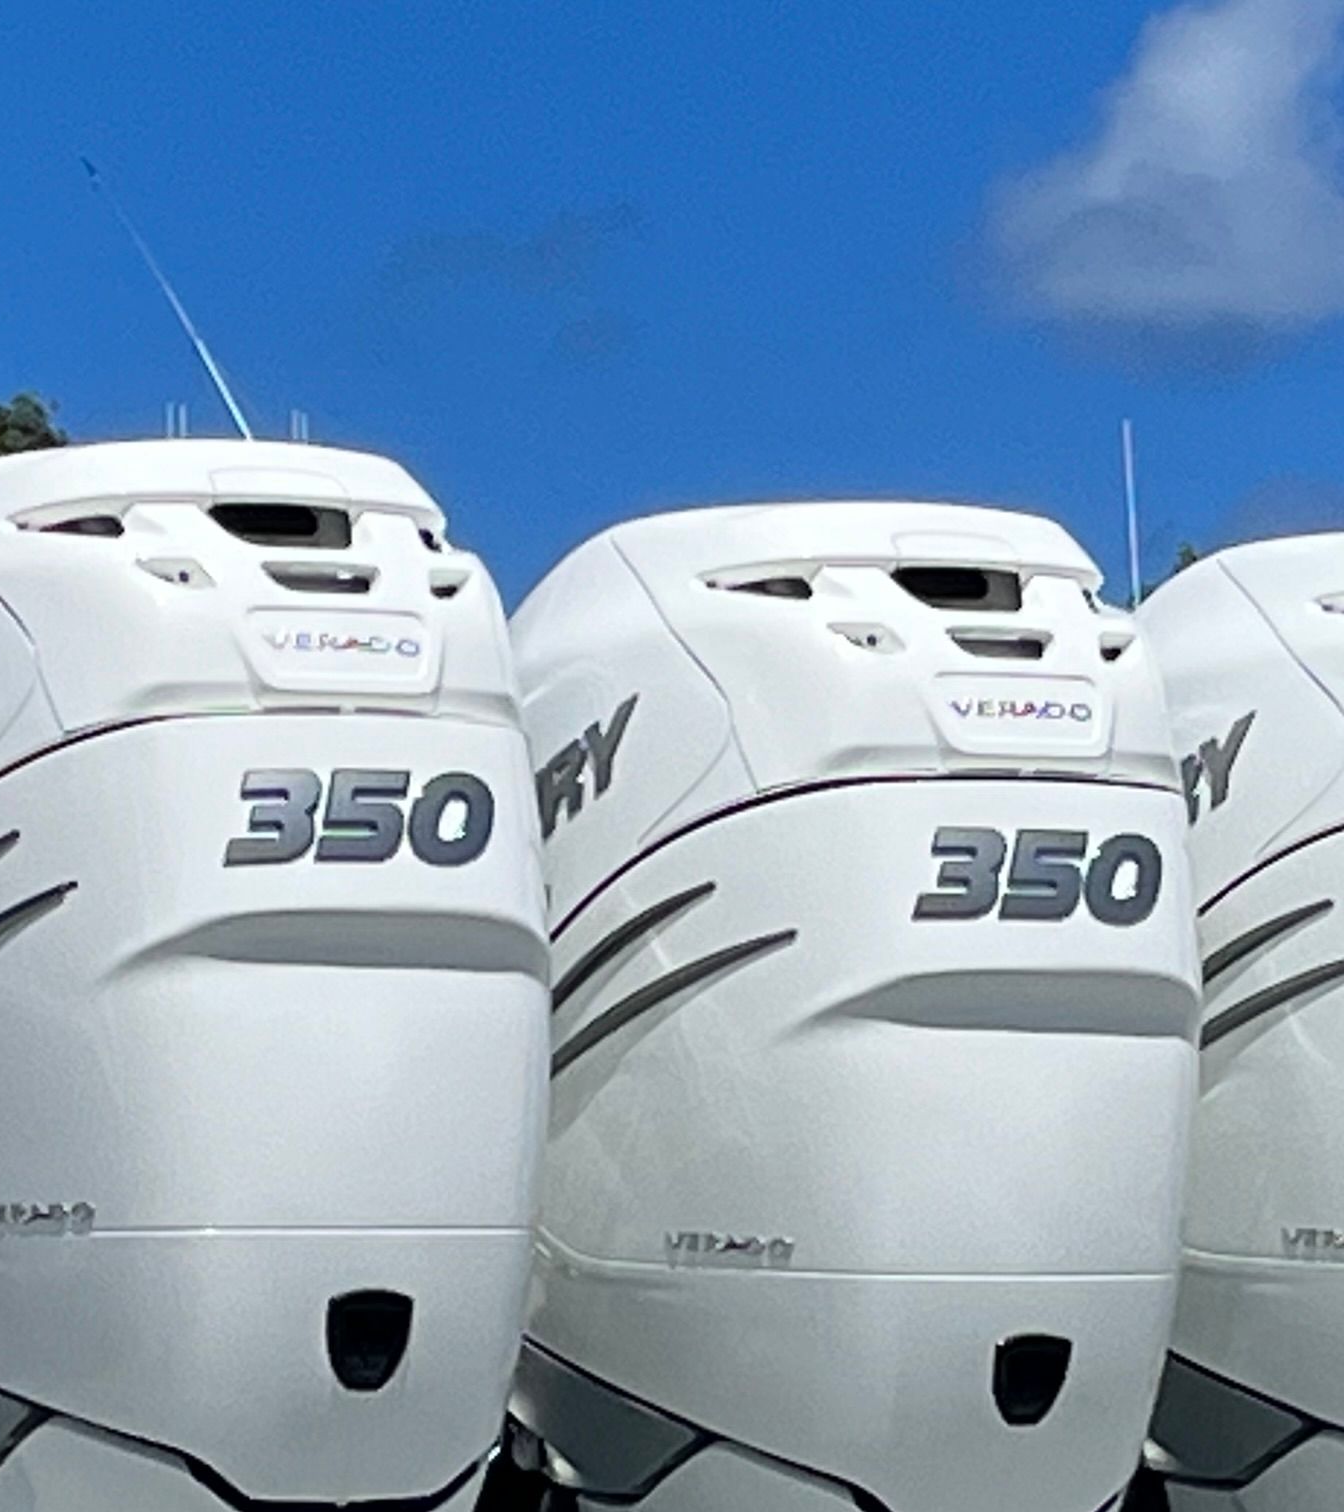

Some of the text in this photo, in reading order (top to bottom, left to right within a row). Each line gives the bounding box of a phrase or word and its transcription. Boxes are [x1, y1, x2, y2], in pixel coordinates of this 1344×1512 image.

[262, 633, 420, 657] VERADO
[948, 699, 1093, 722] VERADO
[223, 768, 494, 868] 350
[910, 826, 1162, 926] 350
